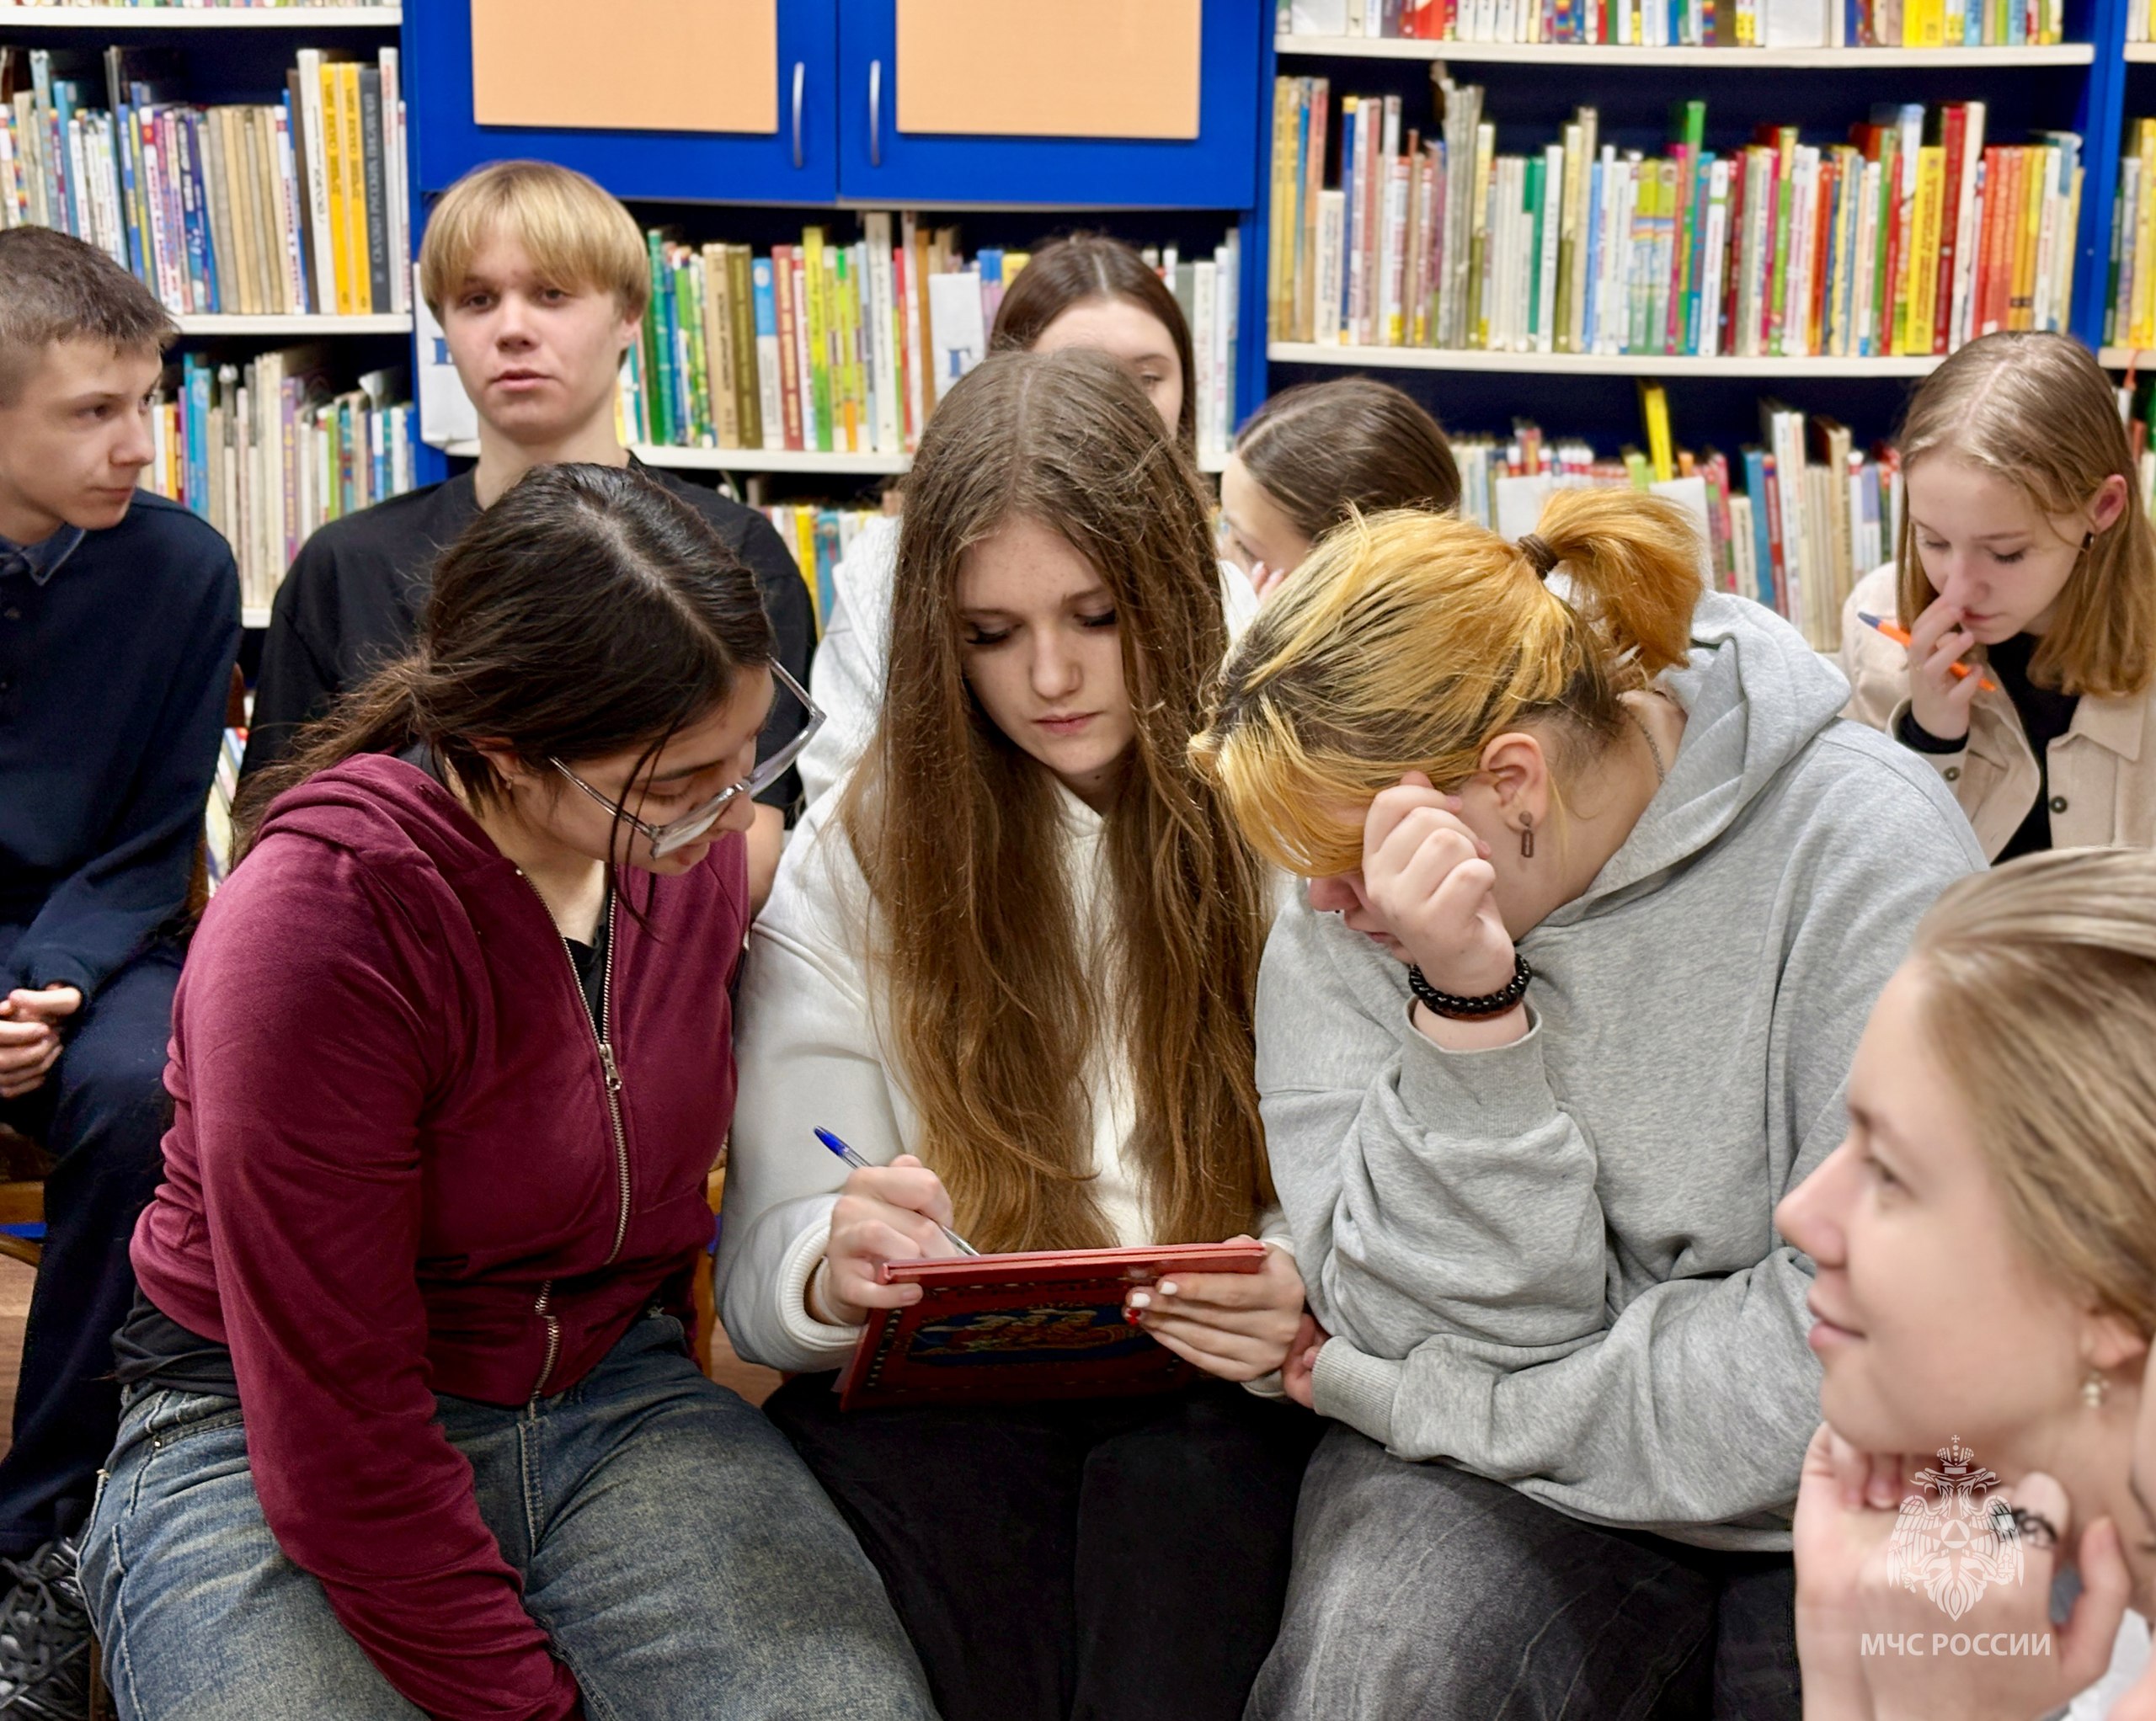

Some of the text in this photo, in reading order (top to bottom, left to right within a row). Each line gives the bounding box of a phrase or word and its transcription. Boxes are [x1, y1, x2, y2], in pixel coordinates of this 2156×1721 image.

[326, 114, 337, 150] СКАЗКИ
[345, 118, 358, 154] СКАЗКИ
[363, 93, 384, 264] СКАЗКИ РУССКИХ ПИСАТЕЛЕЙ
